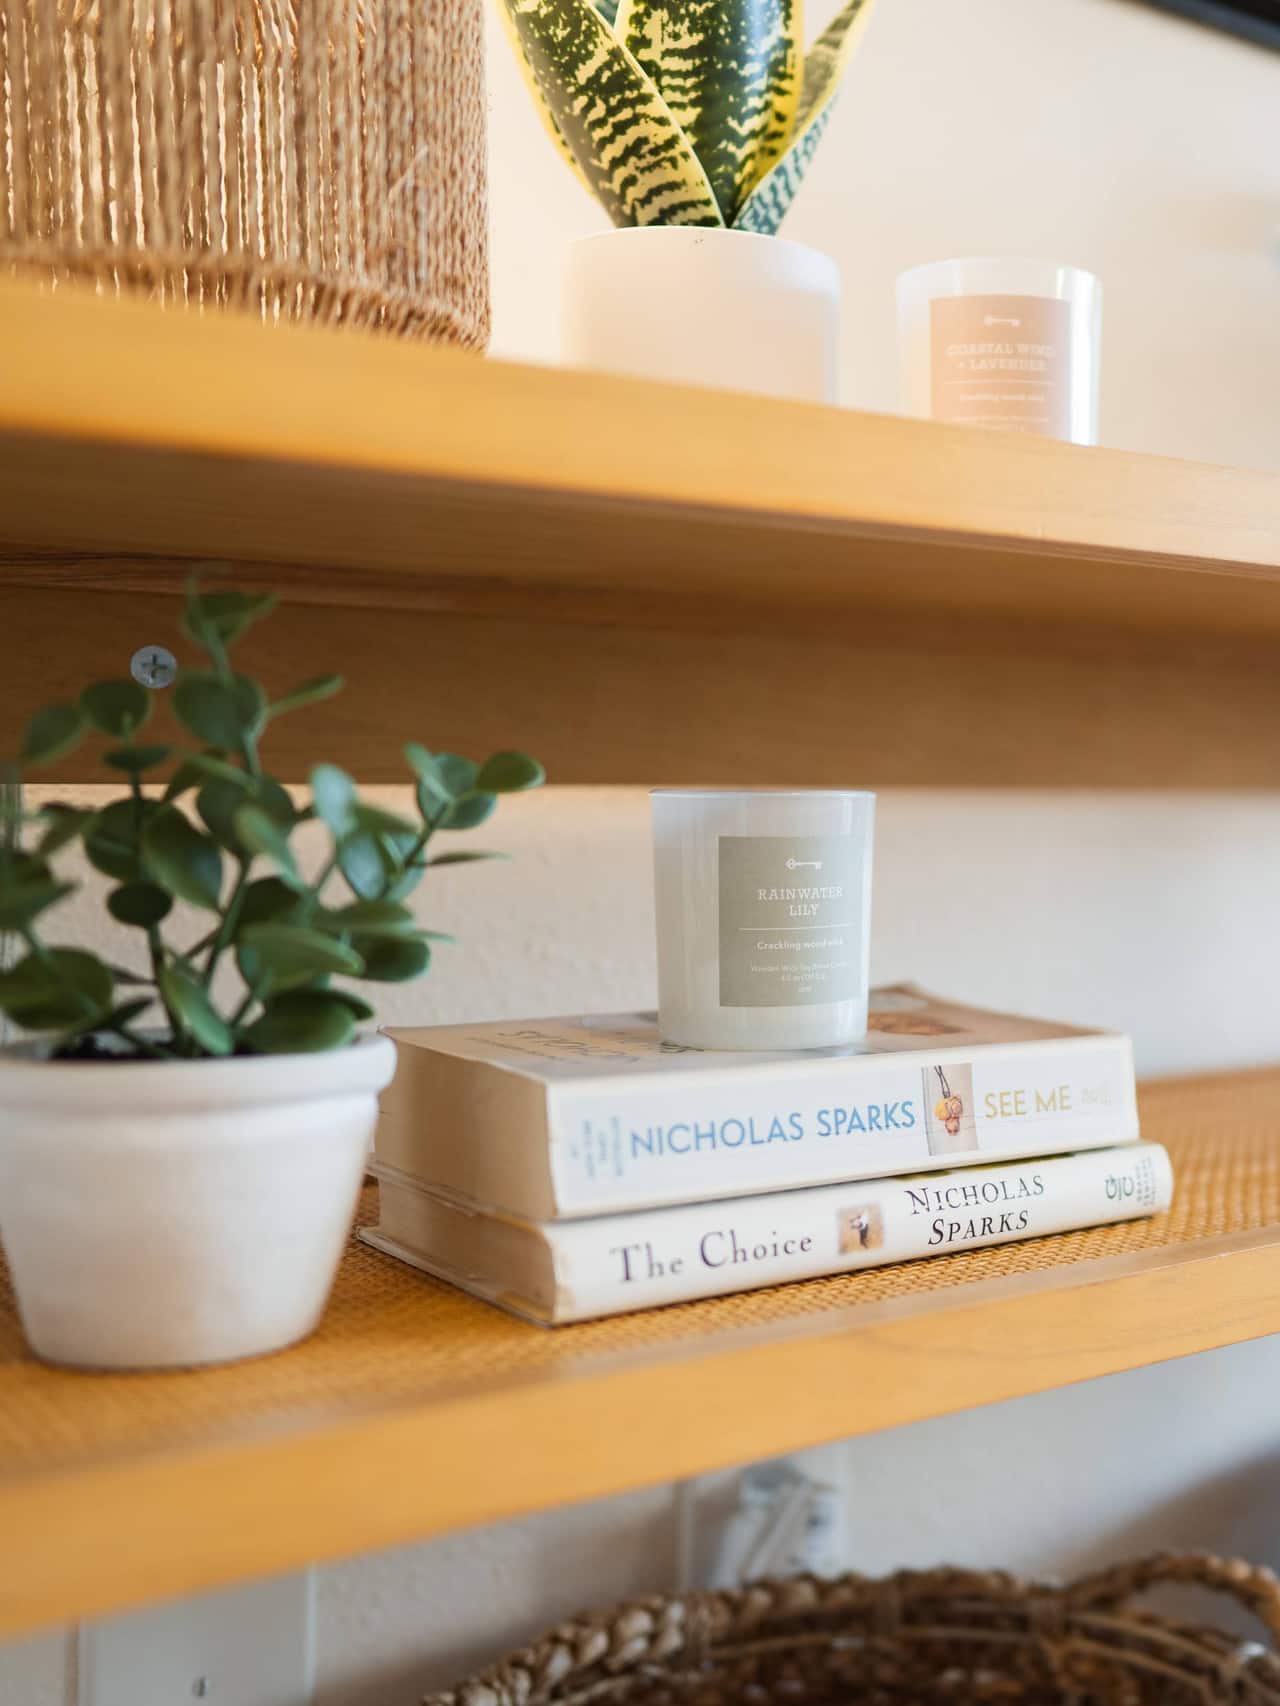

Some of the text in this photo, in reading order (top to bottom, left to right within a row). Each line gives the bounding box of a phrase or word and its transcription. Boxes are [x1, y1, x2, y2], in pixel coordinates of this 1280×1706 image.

[757, 886, 843, 901] RAINWATER
[789, 904, 820, 917] LILY
[630, 1112, 804, 1159] NICHOLAS
[816, 1100, 916, 1137] SPARKS
[983, 1089, 1027, 1120] SEE
[1035, 1085, 1073, 1112] ME
[905, 1175, 1045, 1215] NICHOLAS
[928, 1210, 1029, 1246] SPARKS
[609, 1229, 813, 1283] The Choice
